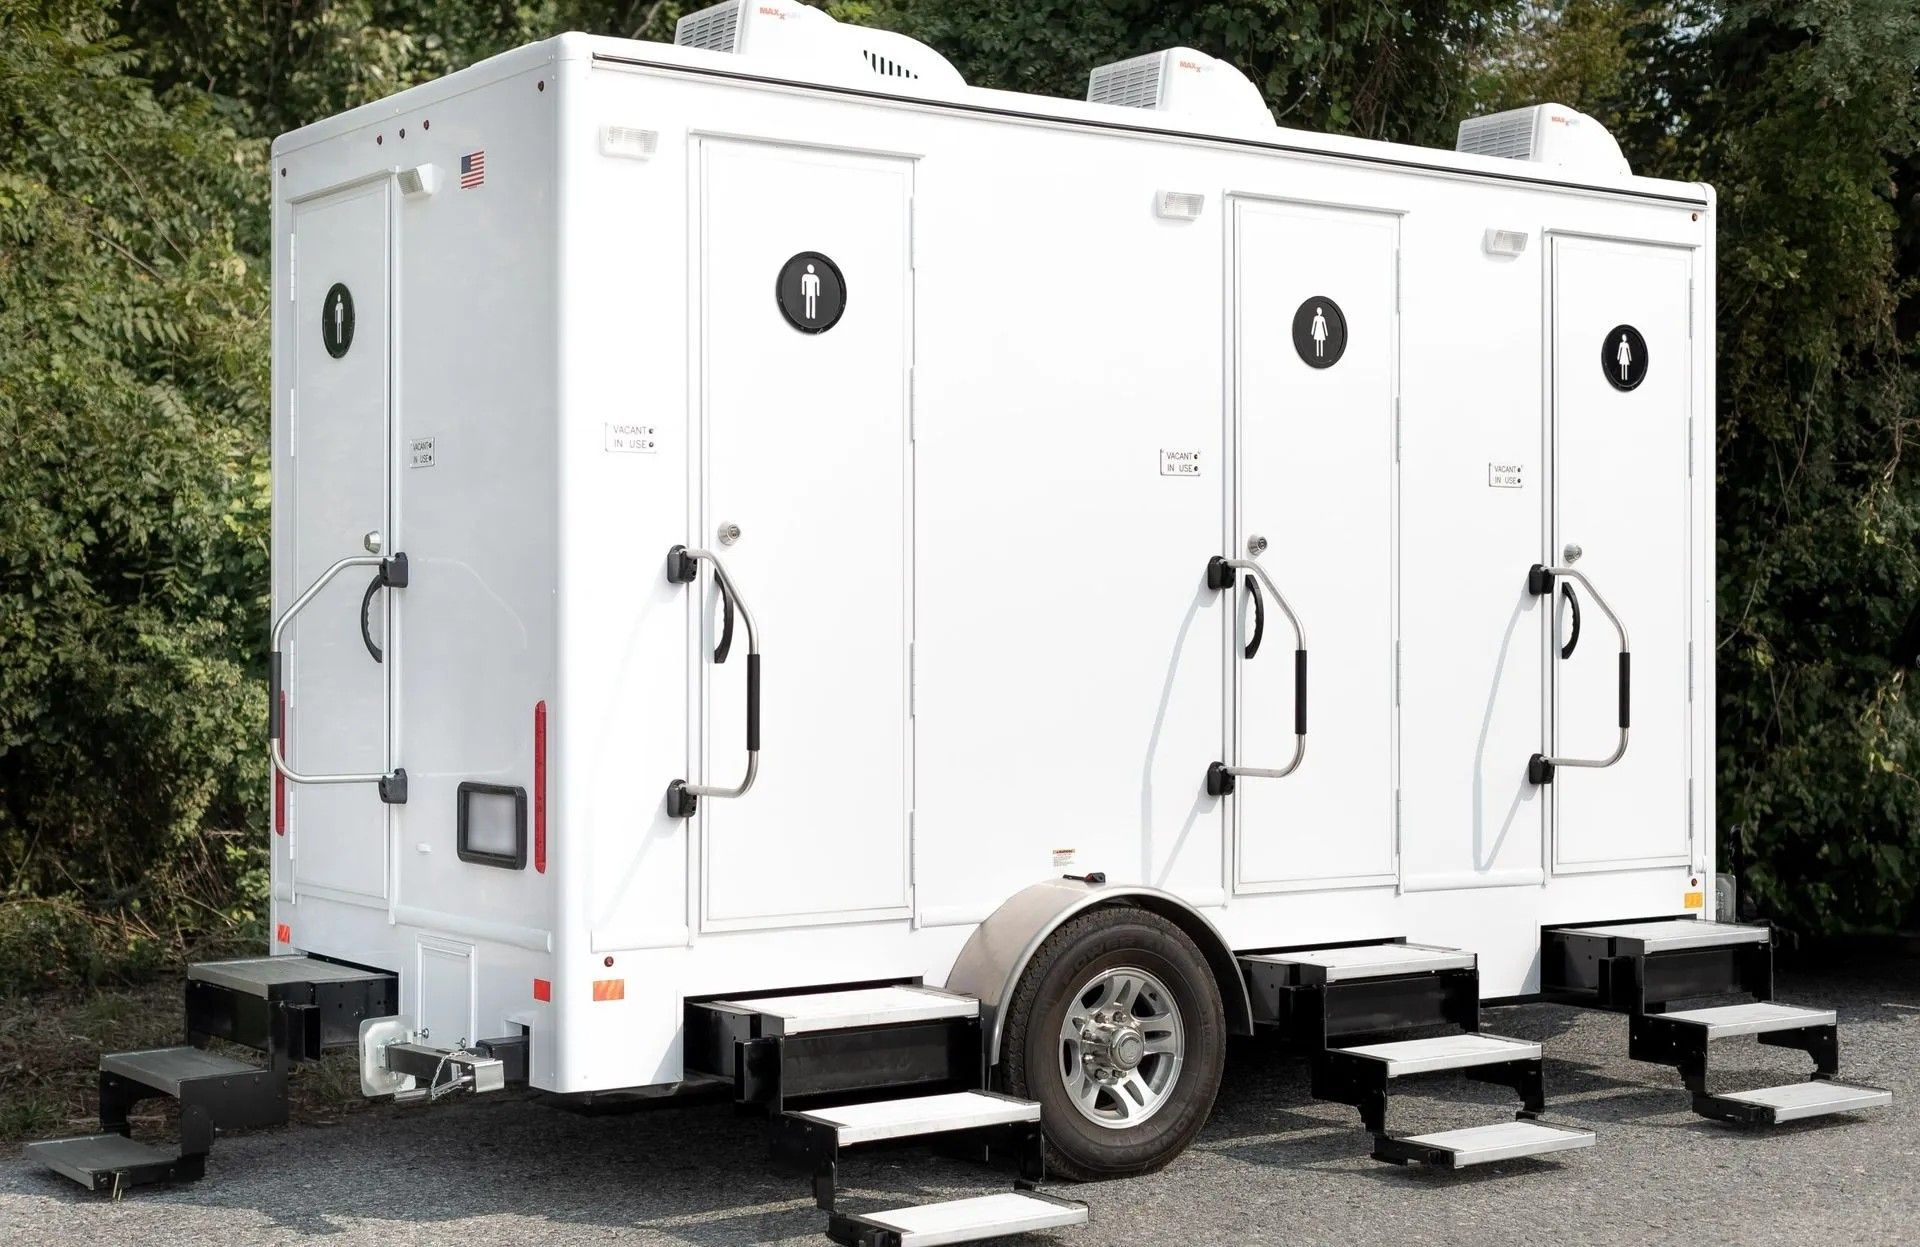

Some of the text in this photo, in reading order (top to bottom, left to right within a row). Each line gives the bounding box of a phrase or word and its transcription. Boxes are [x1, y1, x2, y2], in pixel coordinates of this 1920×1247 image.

[613, 425, 647, 435] VACANT
[614, 439, 647, 449] IN USE
[1166, 451, 1193, 460] VACANT
[1167, 463, 1193, 473] IN USE
[1494, 465, 1517, 473] VACANT
[1494, 476, 1517, 485] IN USE
